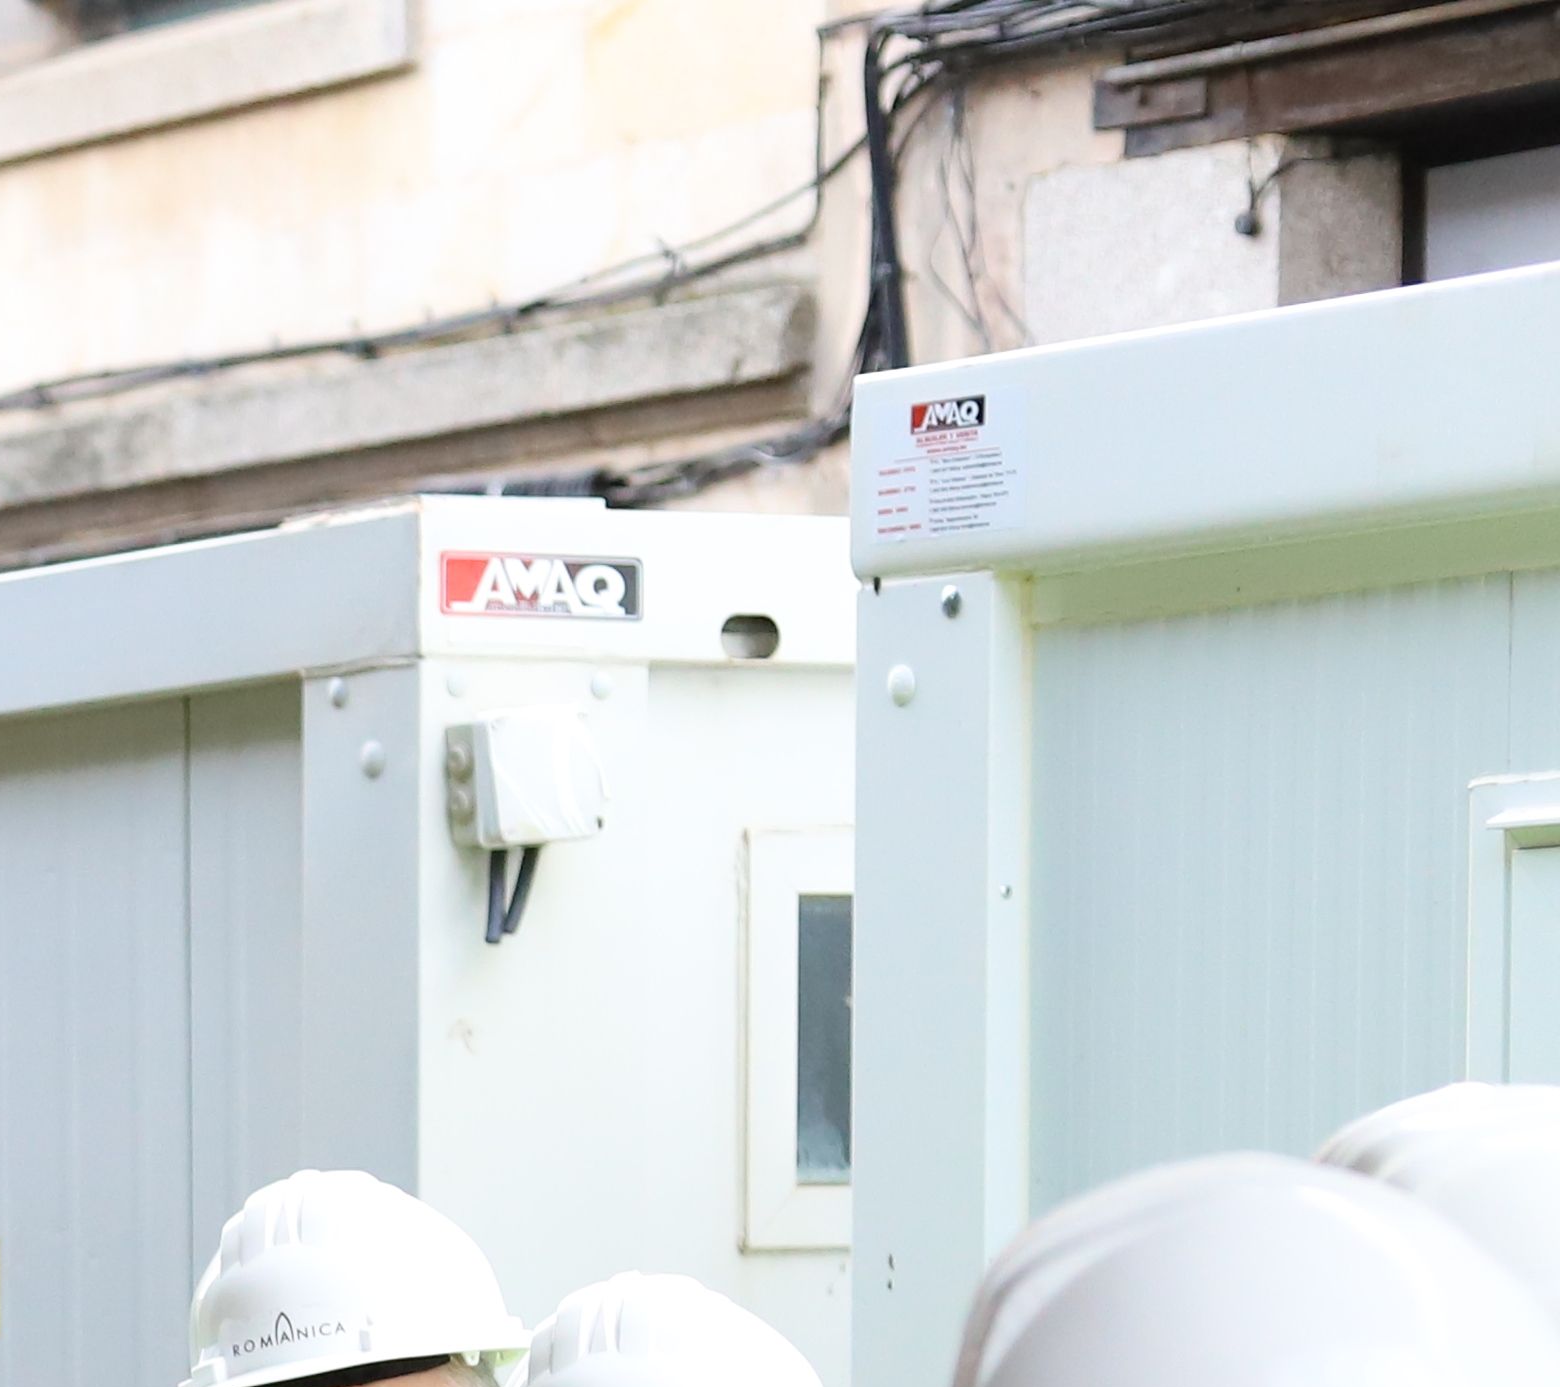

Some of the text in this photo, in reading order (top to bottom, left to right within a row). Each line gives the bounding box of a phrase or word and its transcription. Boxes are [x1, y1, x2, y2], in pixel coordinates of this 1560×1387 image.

[913, 400, 979, 432] AMAQ
[450, 557, 626, 615] AMAQ
[232, 1318, 345, 1357] ROMANICA
